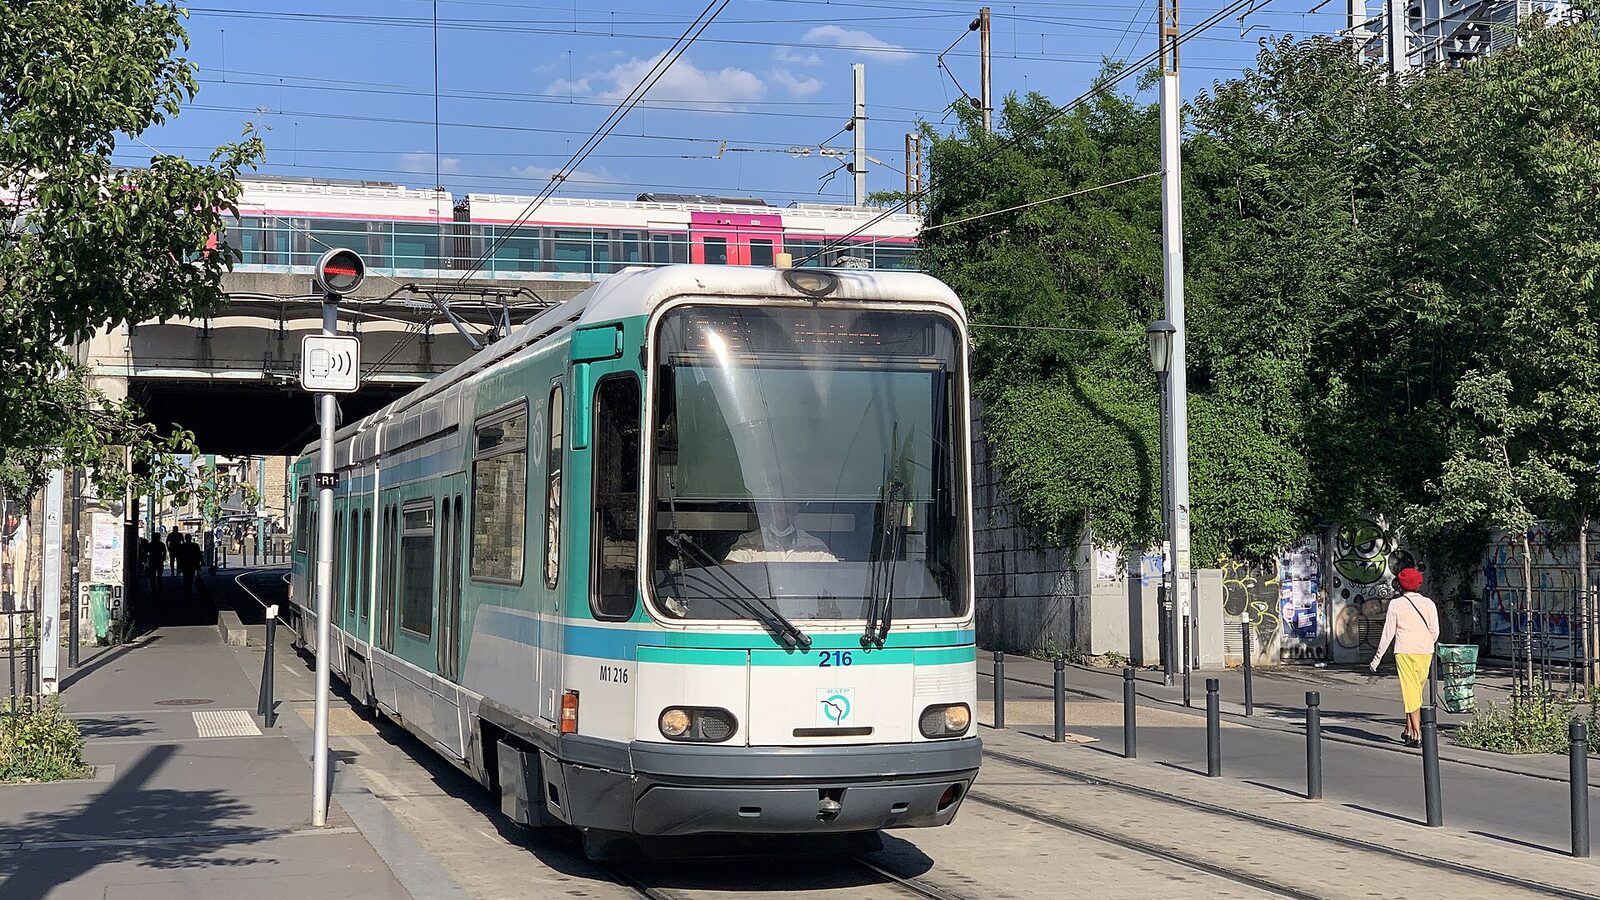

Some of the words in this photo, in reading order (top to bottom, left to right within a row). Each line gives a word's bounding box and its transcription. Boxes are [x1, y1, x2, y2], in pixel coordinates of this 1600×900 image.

[819, 650, 852, 667] 216
[599, 665, 611, 682] M1
[613, 667, 628, 684] 216
